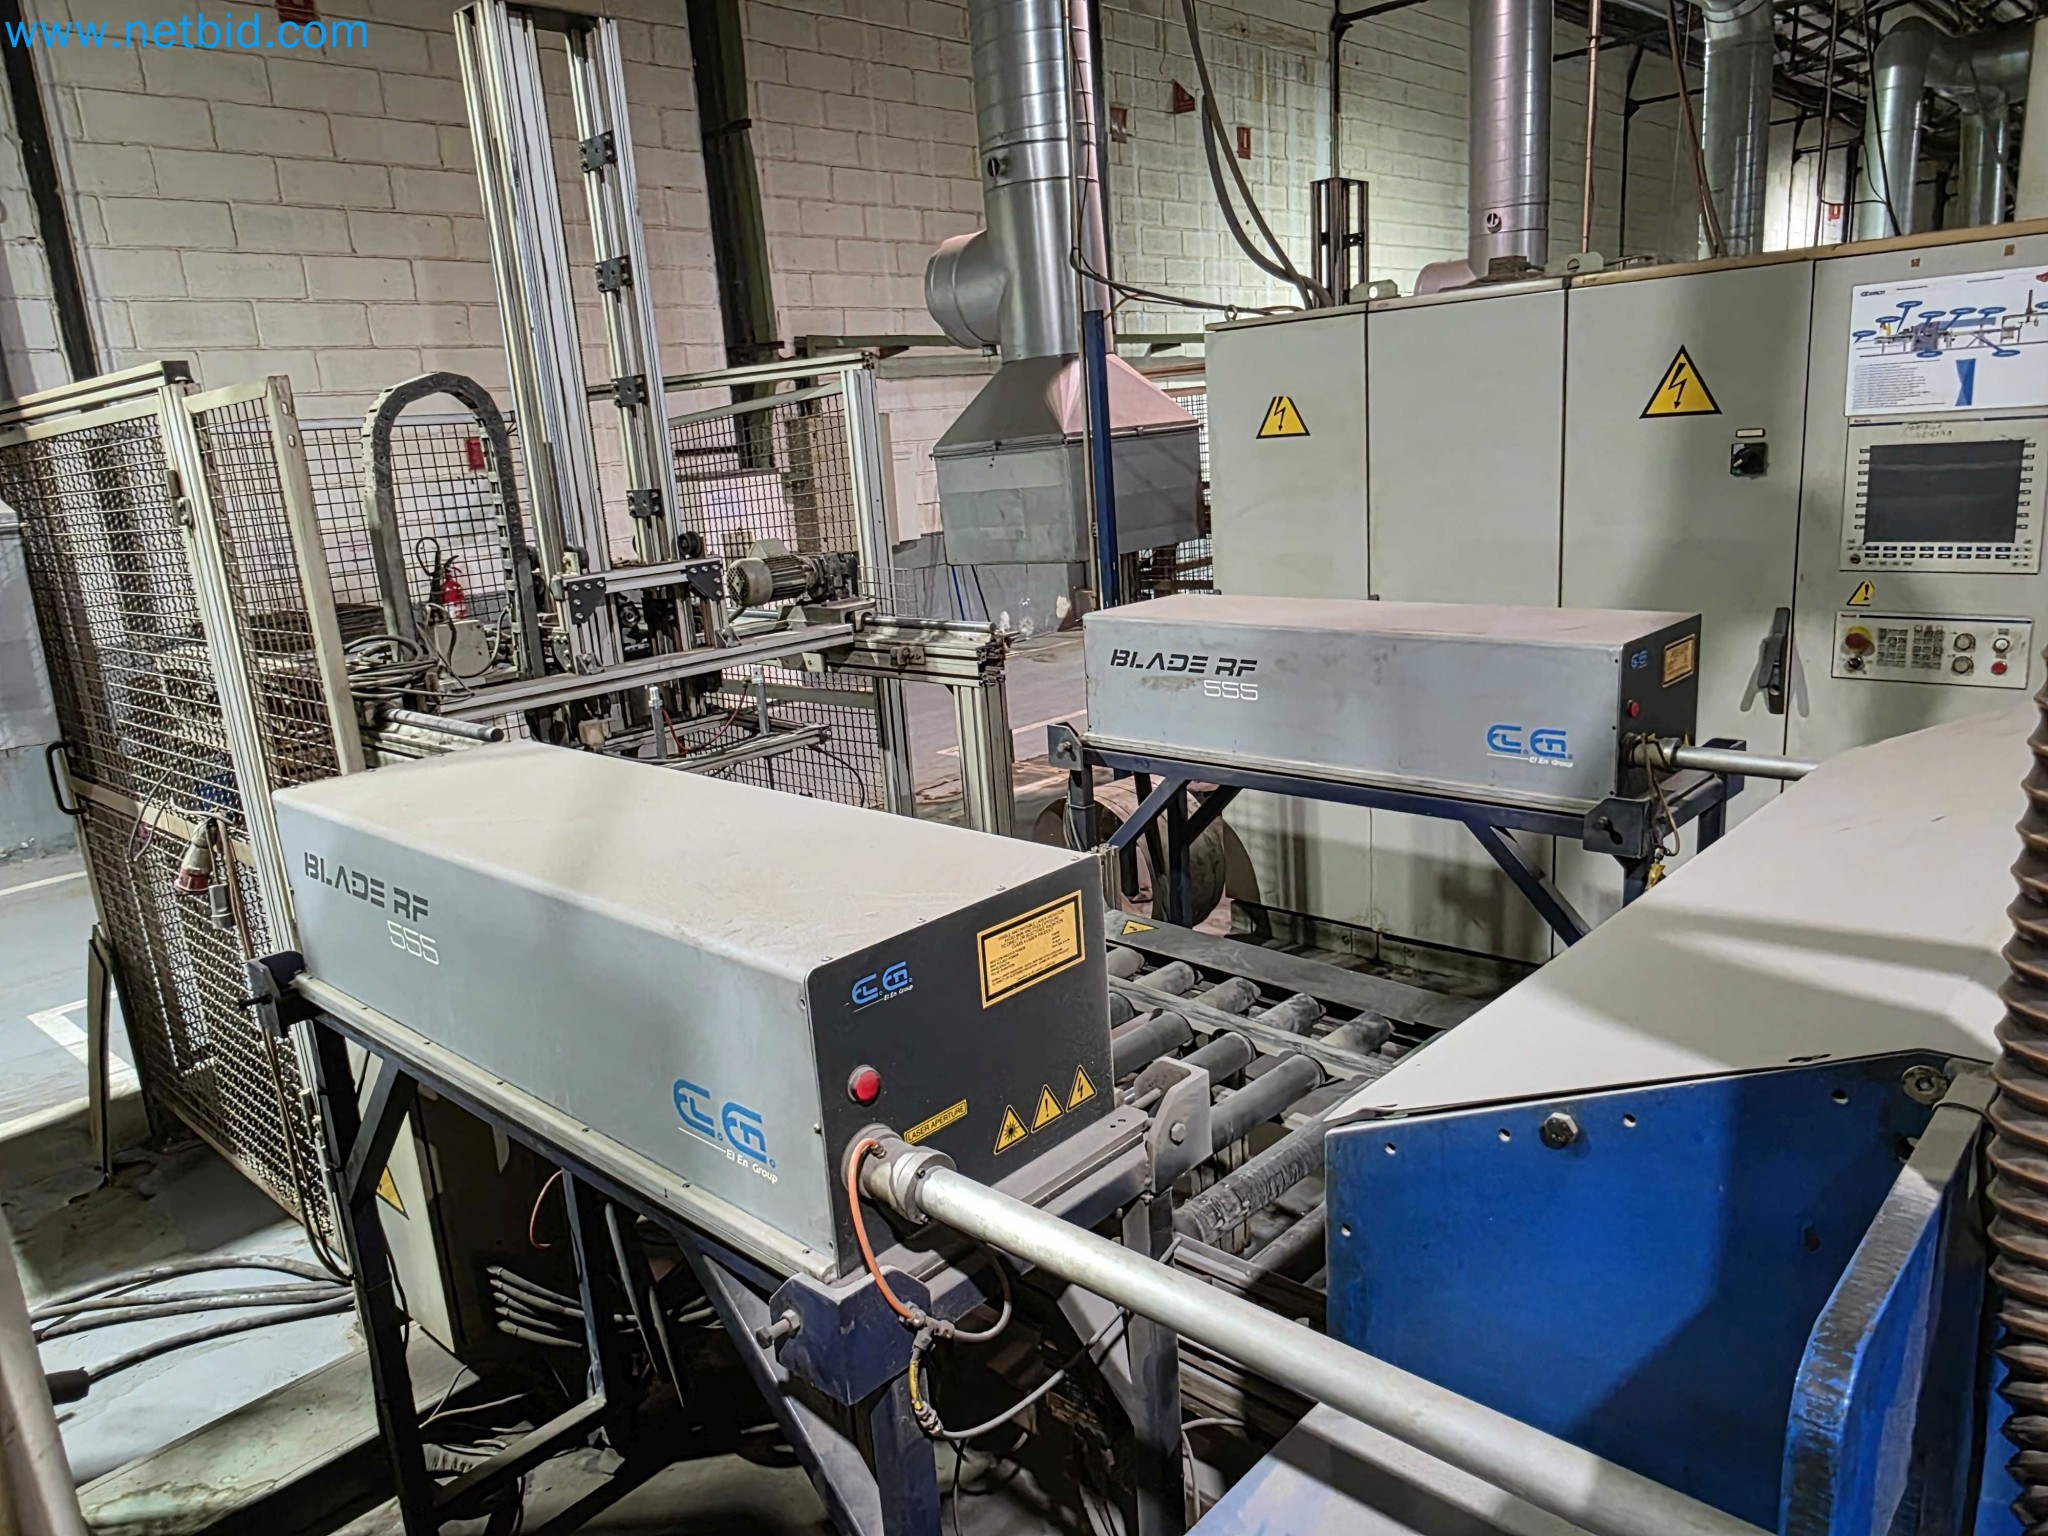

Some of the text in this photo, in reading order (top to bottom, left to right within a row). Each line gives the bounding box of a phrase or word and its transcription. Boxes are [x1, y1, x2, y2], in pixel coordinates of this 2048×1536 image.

[1110, 648, 1258, 677] BLADE RF
[1203, 679, 1258, 701] 555
[304, 851, 429, 923] BLADE RF
[387, 919, 440, 966] 555
[907, 1105, 965, 1141] LASER APERTURE
[737, 1154, 749, 1168] En
[752, 1163, 778, 1183] Group
